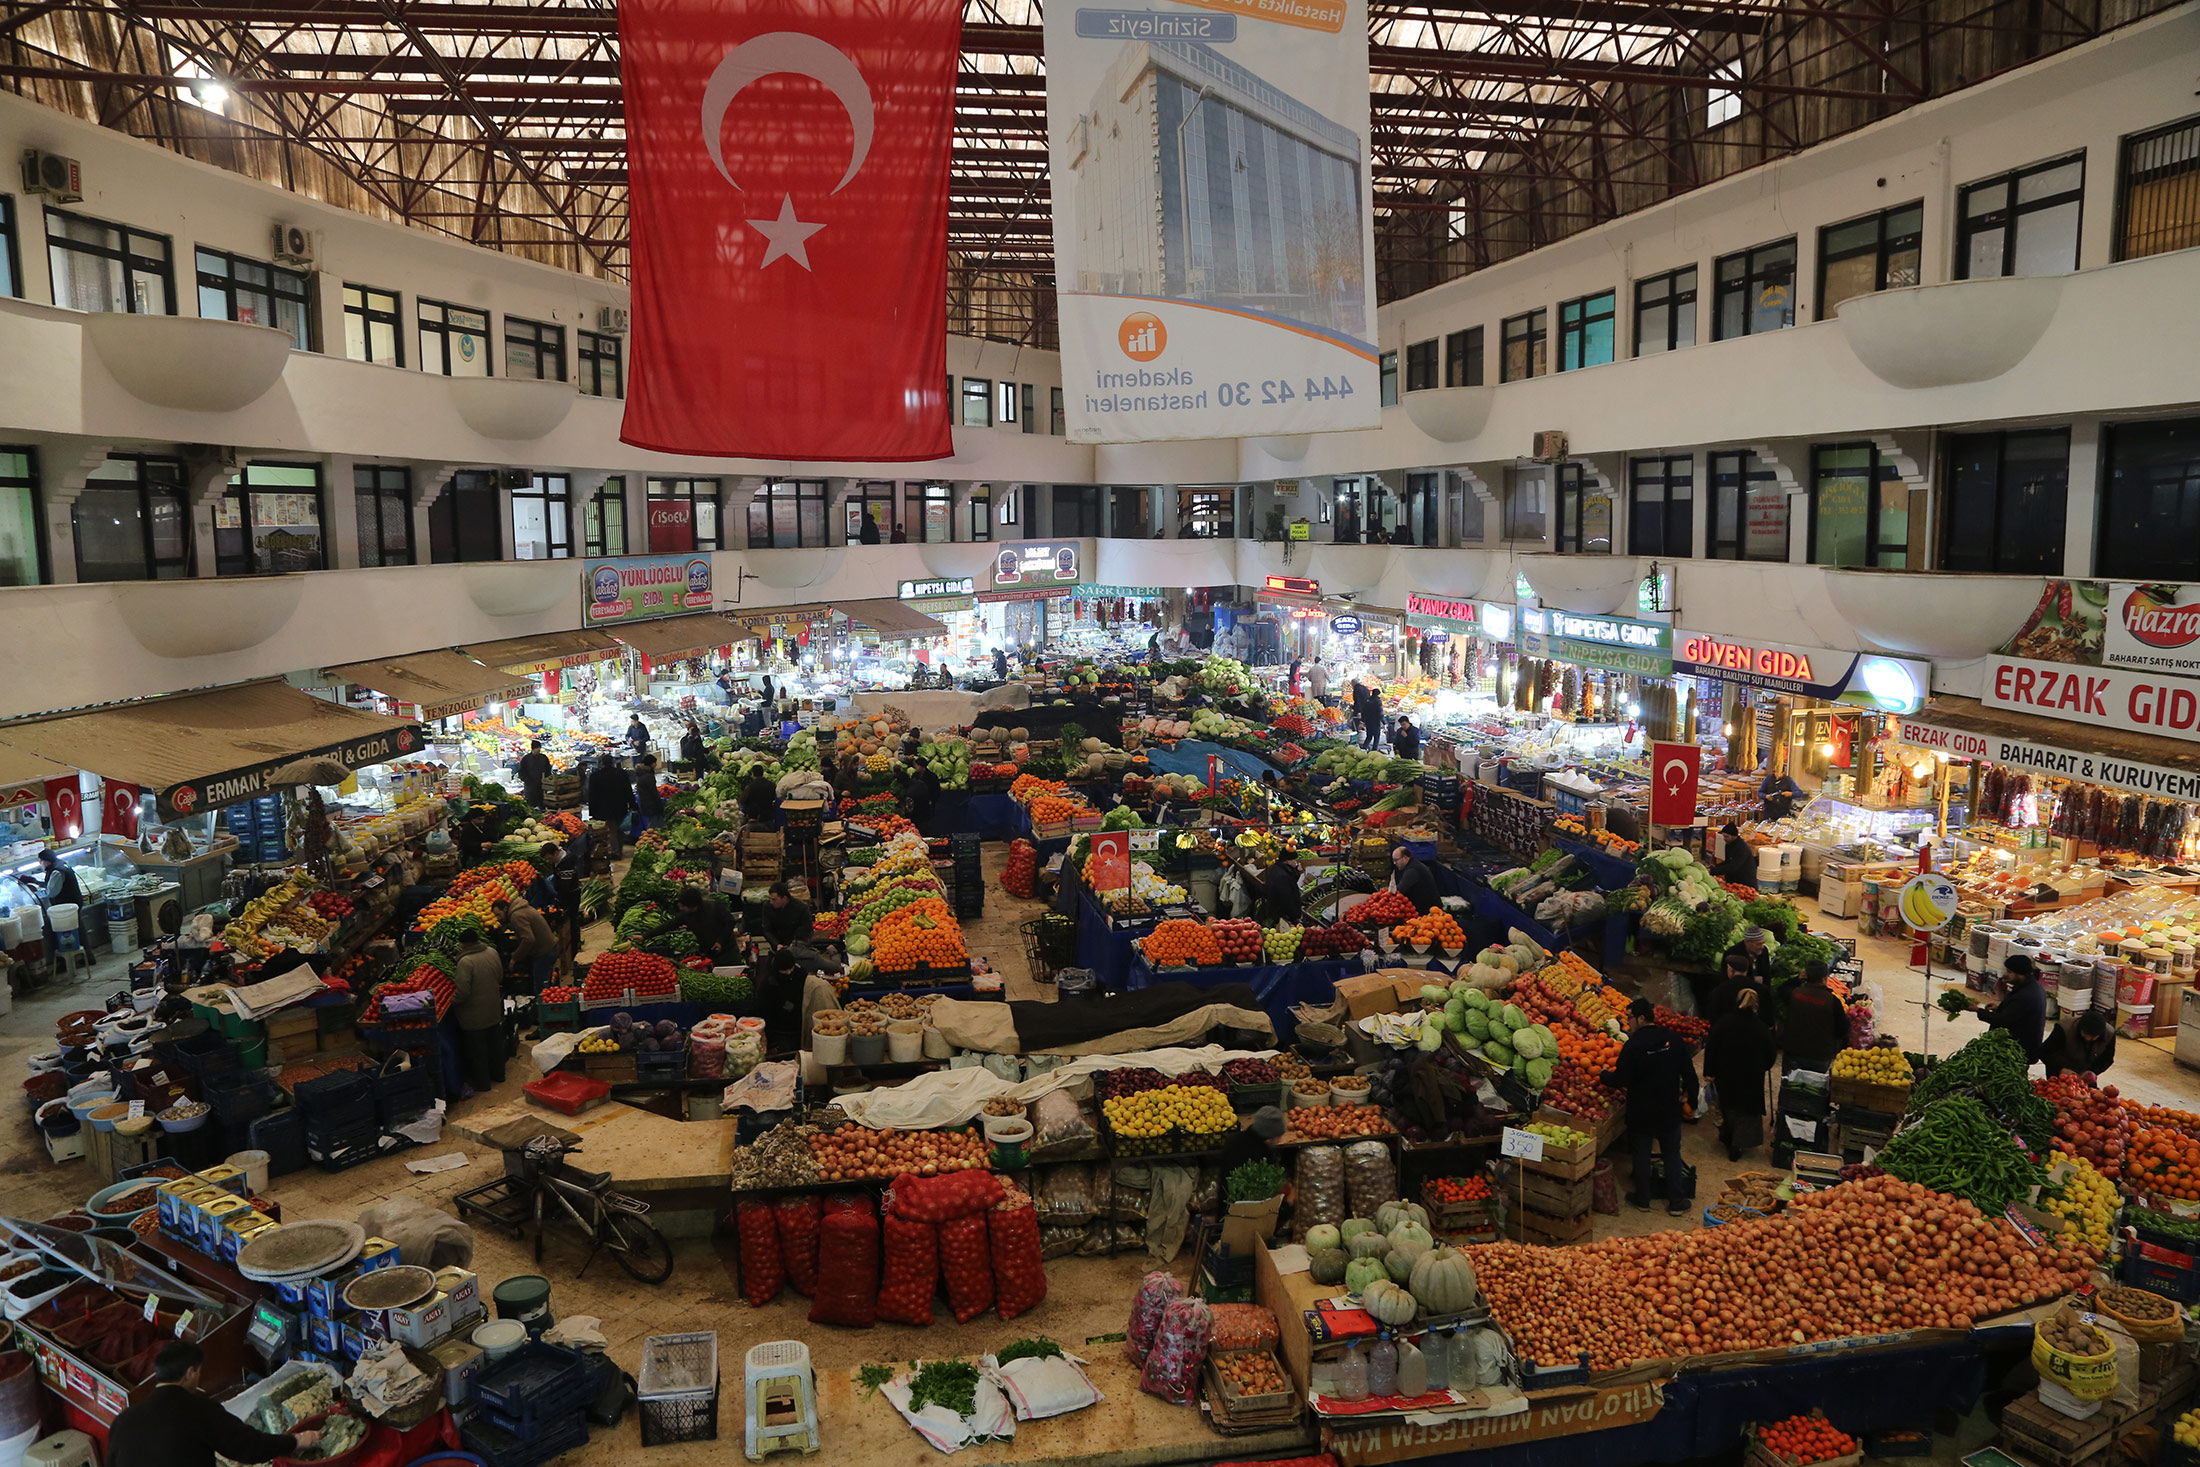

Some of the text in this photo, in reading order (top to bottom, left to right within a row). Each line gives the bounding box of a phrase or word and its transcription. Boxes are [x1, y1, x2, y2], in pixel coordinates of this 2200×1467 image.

[620, 563, 683, 587] YÜNLÜOĞLU
[946, 580, 962, 593] GIDA
[642, 590, 664, 607] GIDA
[1407, 593, 1475, 622] ÖZ YAVUZ GIDA
[741, 610, 826, 627] KONYA BAL PAZARI
[1620, 624, 1660, 647] GIDA
[534, 663, 546, 672] ve
[600, 649, 621, 660] GIDA
[1626, 654, 1660, 673] GIDA
[1683, 634, 1814, 681] GÜVEN GIDA
[2109, 653, 2149, 665] BAHARAT
[2149, 656, 2173, 669] SATIŞ
[1695, 665, 1804, 693] BAHARAT BAKLİYAT SÜT MAMÜLLERİ
[483, 693, 503, 705] GIDA
[507, 684, 534, 699] PAZARI
[1994, 664, 2200, 733] ERZAK GID
[1904, 724, 1949, 748] ERZAK
[1953, 734, 1988, 757] GIDA
[2000, 743, 2079, 774] BAHARAT
[2081, 759, 2094, 778] &
[206, 772, 261, 804] ERMAN
[345, 748, 356, 765] &
[356, 738, 390, 761] GIDA
[453, 1286, 473, 1302] AKAY
[393, 1312, 411, 1325] AKAY
[423, 1306, 444, 1325] AKAY
